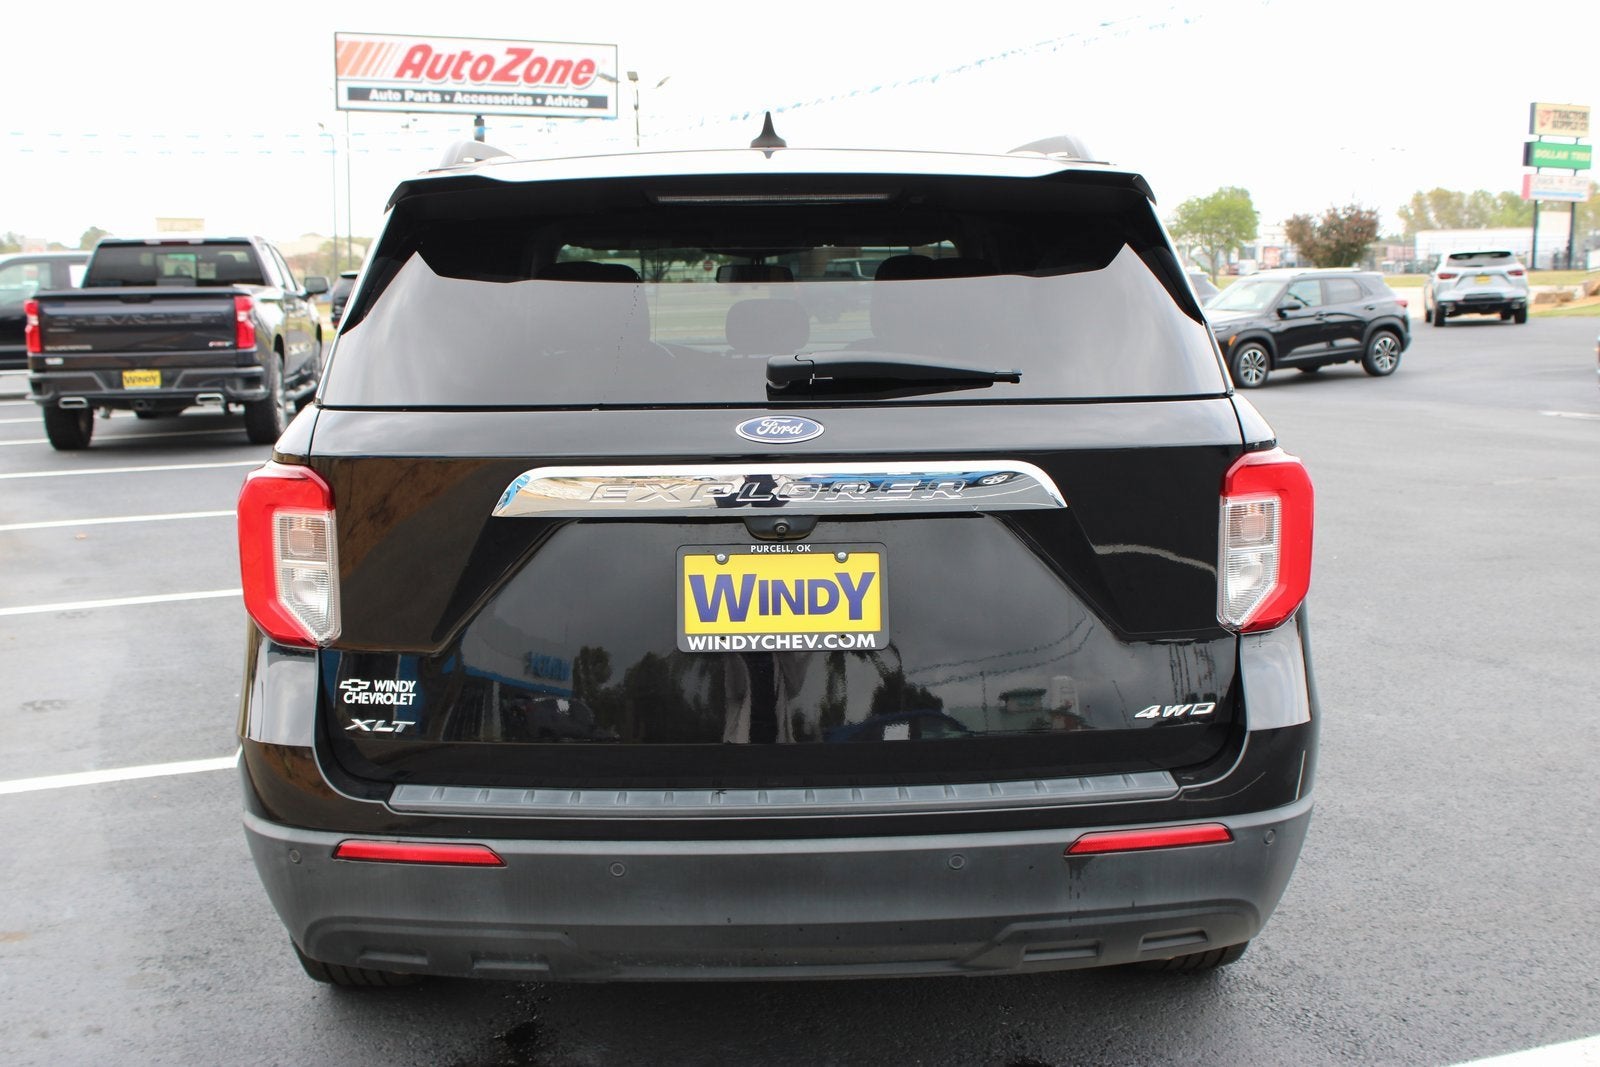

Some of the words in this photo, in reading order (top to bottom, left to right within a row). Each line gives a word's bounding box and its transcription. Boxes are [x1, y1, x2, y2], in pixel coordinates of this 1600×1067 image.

[395, 44, 595, 86] AutoZone
[369, 89, 402, 102] Auto
[405, 90, 441, 103] Parts
[453, 92, 533, 106] Accessories
[545, 94, 589, 108] Advice
[756, 419, 804, 435] Ford
[588, 479, 967, 502] EXPLORER
[750, 545, 794, 554] PURCELL,
[796, 544, 811, 553] OK
[687, 633, 876, 651] WINDYCHEV.COM
[373, 679, 417, 692] WINDY
[343, 691, 417, 706] CHEVROLET
[1134, 701, 1216, 719] 4WD
[344, 718, 416, 733] XLT
